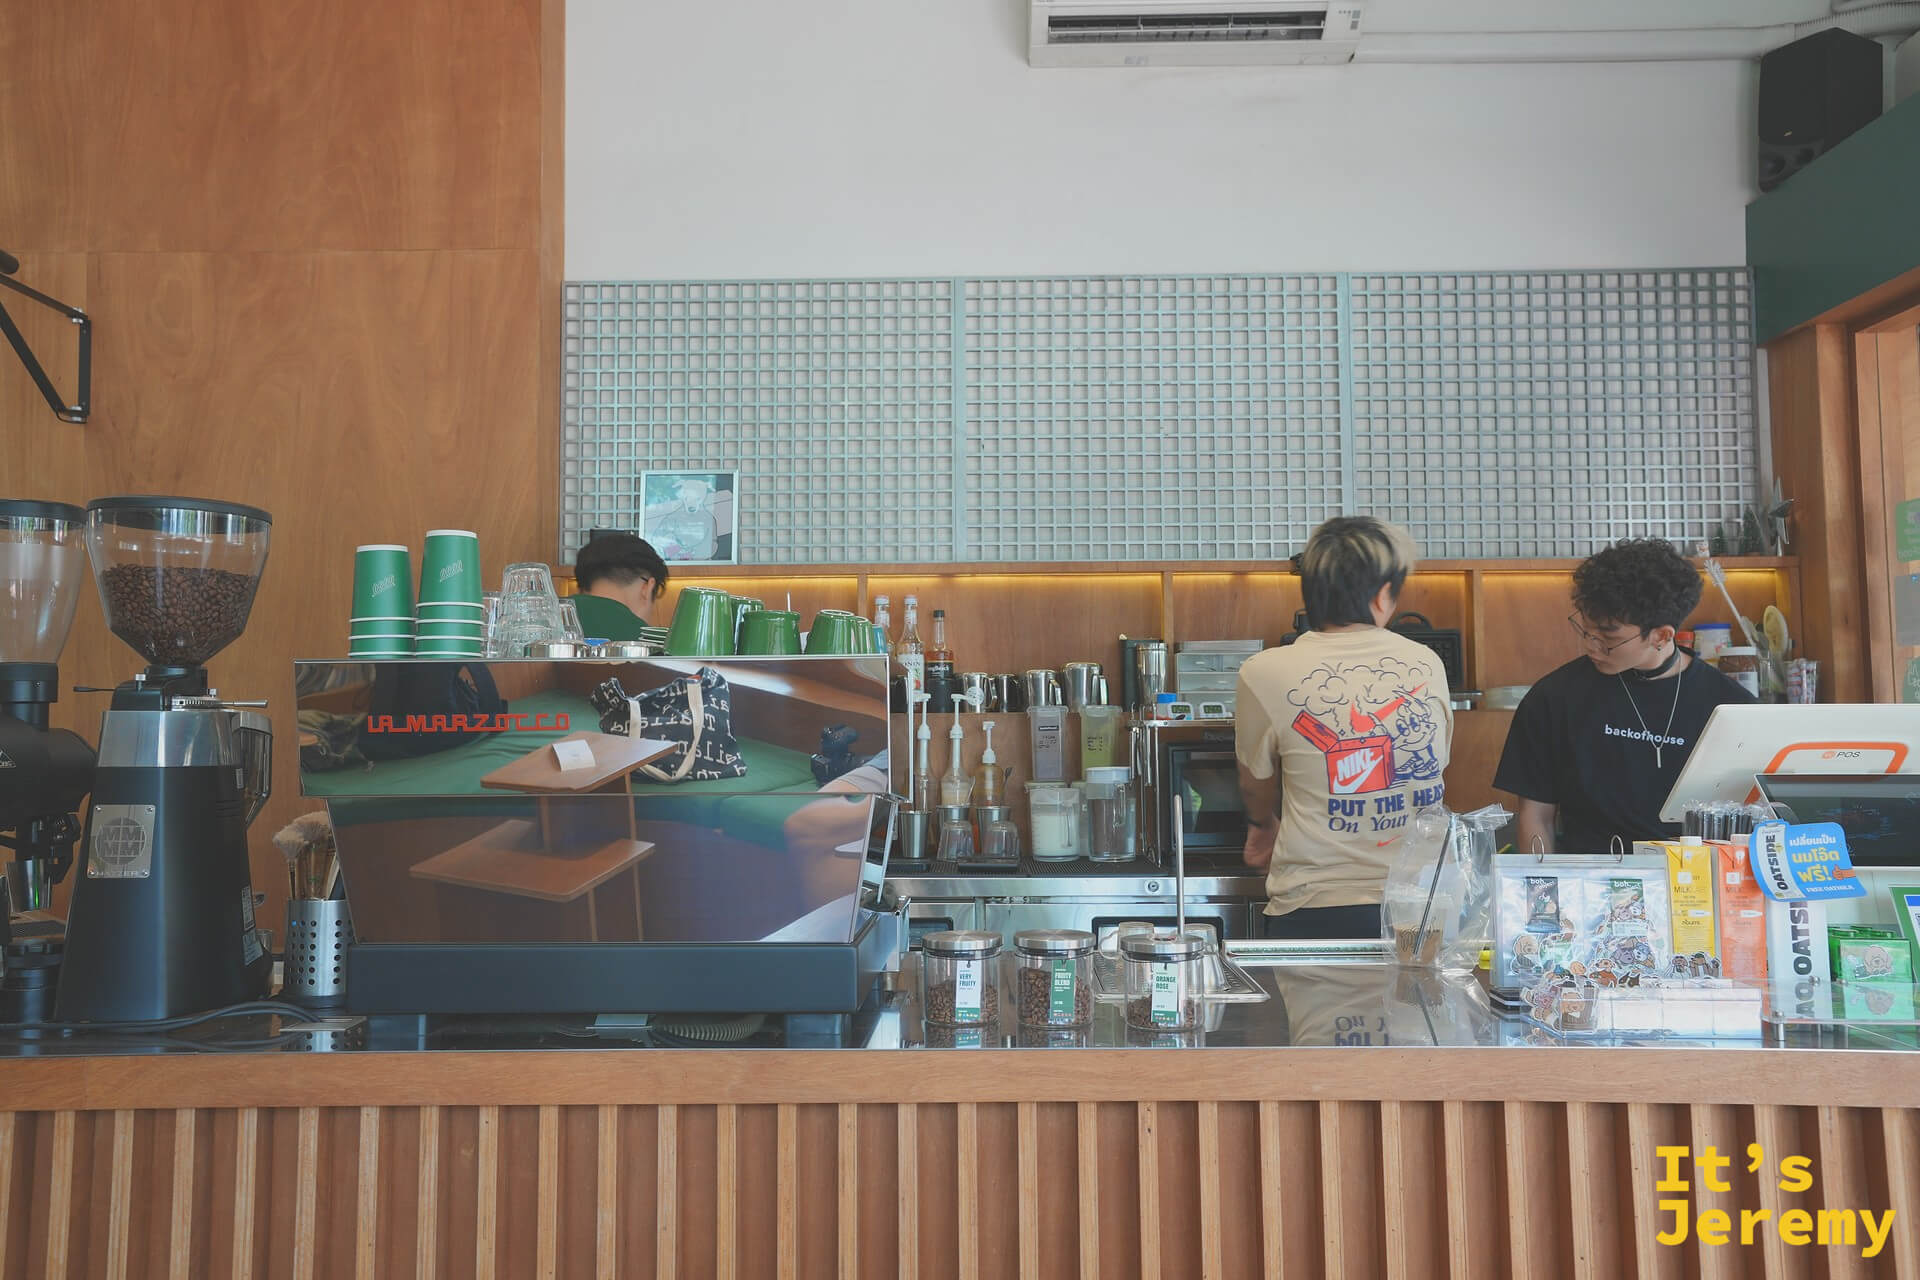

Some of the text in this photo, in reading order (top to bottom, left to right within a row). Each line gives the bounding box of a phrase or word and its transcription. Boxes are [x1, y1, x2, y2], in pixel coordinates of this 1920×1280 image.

[368, 715, 392, 732] LA
[1605, 724, 1685, 745] backofhouse
[1336, 748, 1374, 781] NIKE
[1328, 798, 1366, 817] PUT
[1374, 793, 1405, 815] THE
[1413, 784, 1444, 807] HEA
[1328, 814, 1408, 833] On Your
[1766, 834, 1789, 890] OATSIDE
[1789, 901, 1812, 976] OATSI
